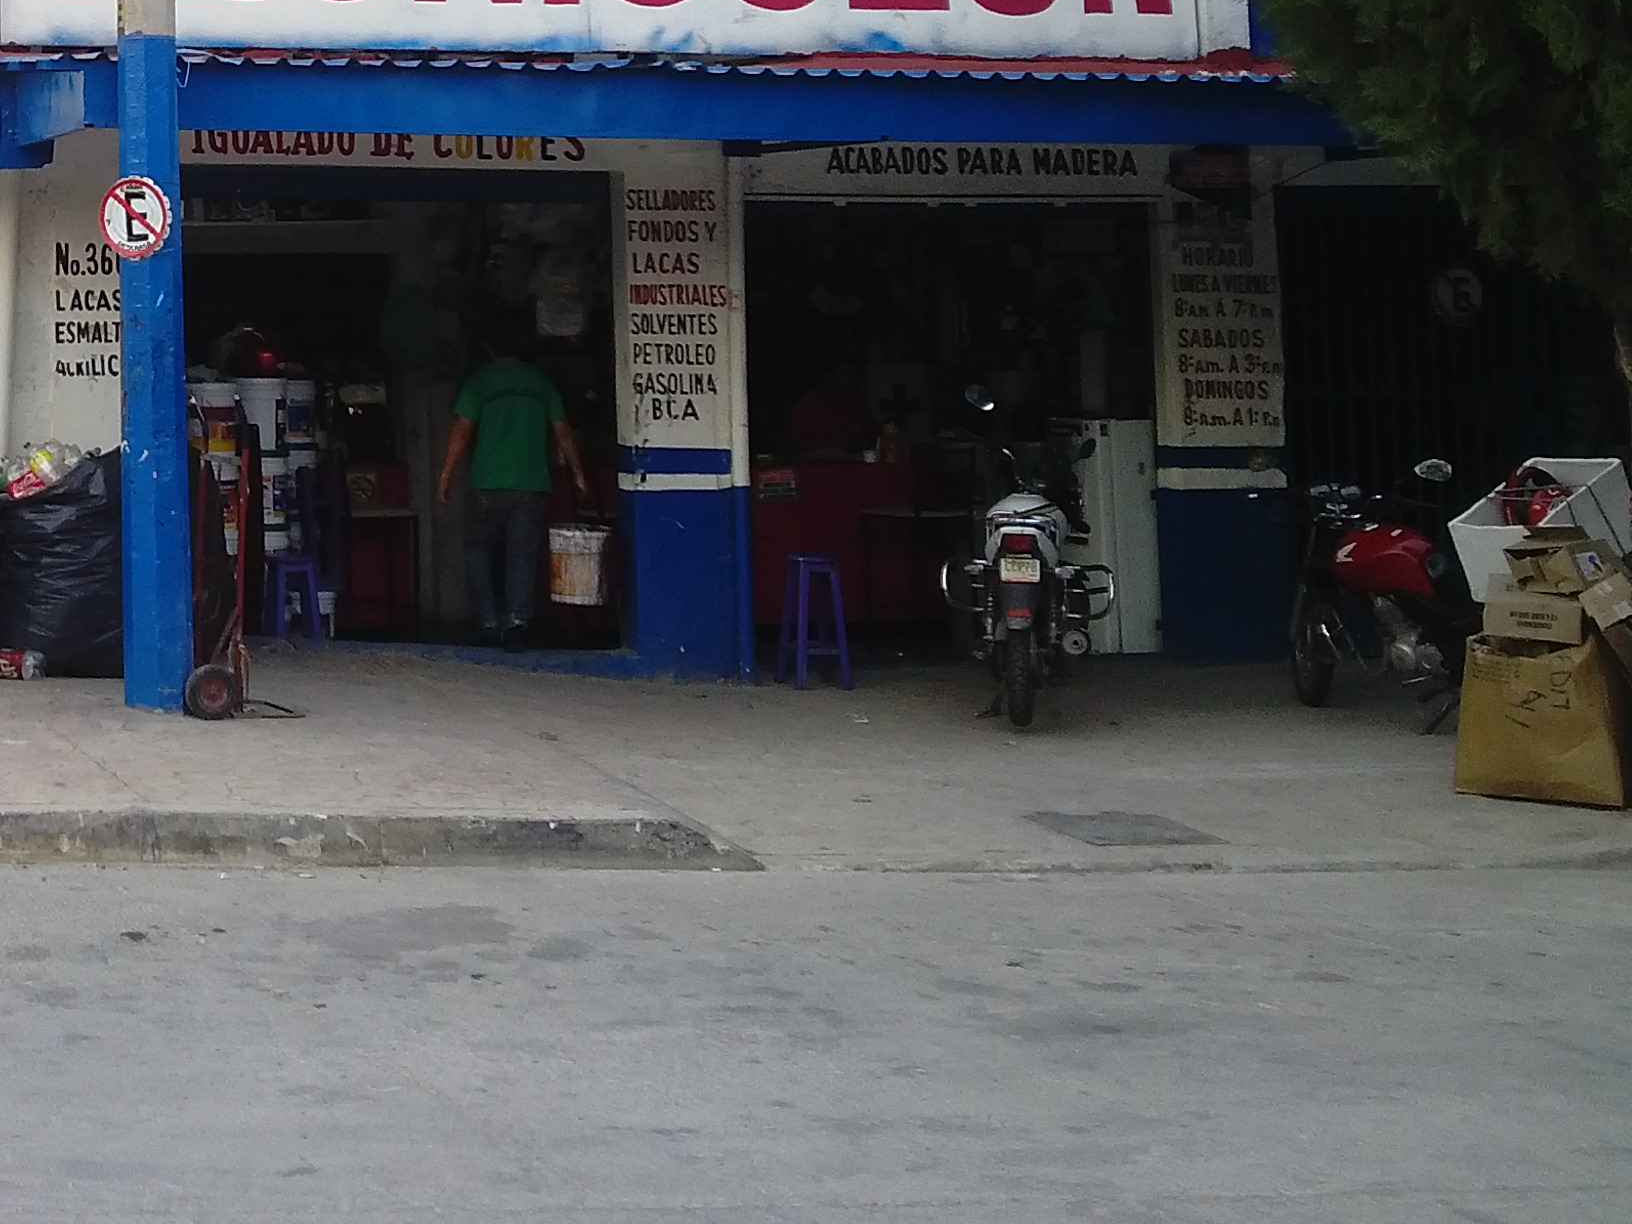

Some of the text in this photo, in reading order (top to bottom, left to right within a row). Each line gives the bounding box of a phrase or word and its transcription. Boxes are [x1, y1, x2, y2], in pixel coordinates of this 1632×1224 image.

[191, 130, 586, 162] IGUALADO DE COLORES
[826, 146, 1138, 176] ACABADOS PARA MADERA
[625, 188, 717, 212] SELLADORES
[627, 220, 717, 243] FONDOS Y
[54, 241, 120, 277] No.36
[632, 252, 700, 275] LACAS
[629, 284, 727, 308] INDUSTRIALES
[54, 319, 121, 344] ESMALT
[631, 313, 718, 336] SOLVENTES
[1178, 328, 1265, 348] SABADOS
[633, 343, 716, 366] PETROLEO
[1228, 354, 1240, 373] A
[632, 373, 718, 396] GASOLINA
[1184, 377, 1270, 399] DOMINGOS
[1233, 407, 1244, 426] A
